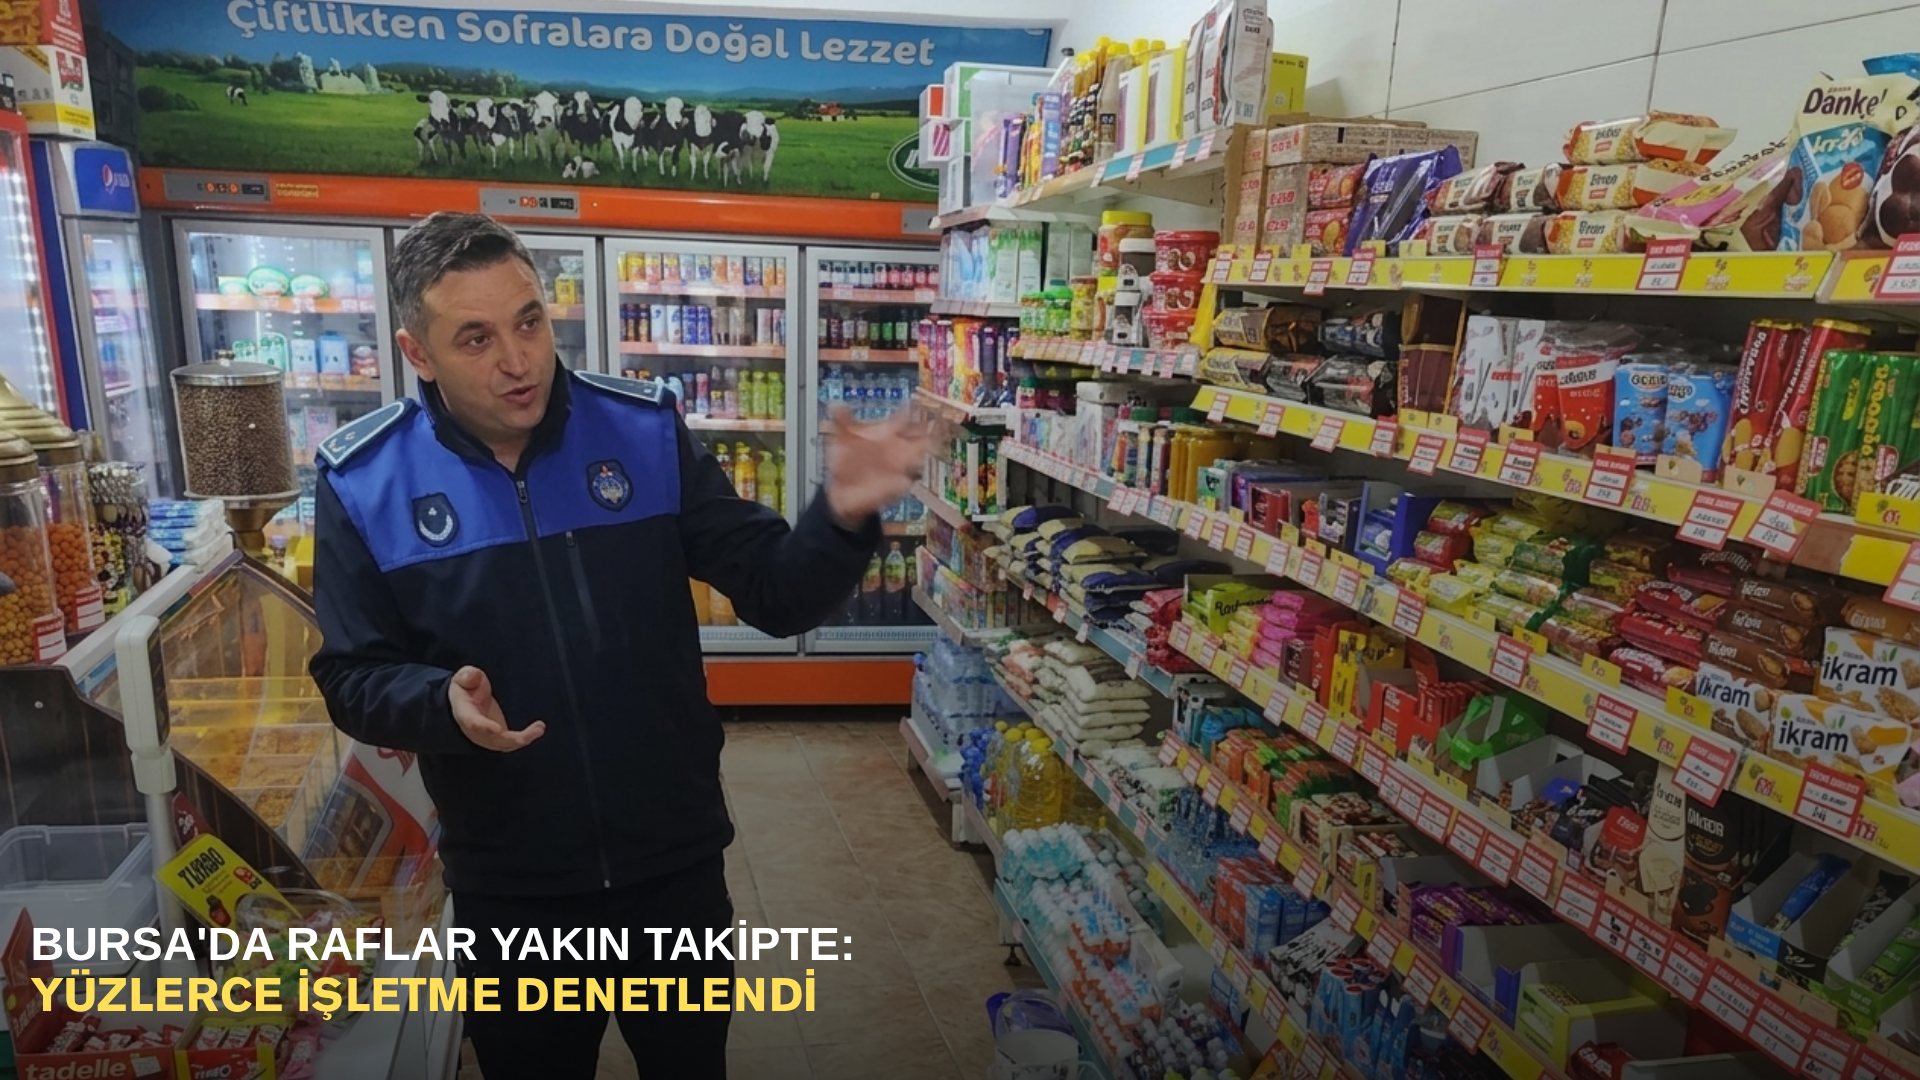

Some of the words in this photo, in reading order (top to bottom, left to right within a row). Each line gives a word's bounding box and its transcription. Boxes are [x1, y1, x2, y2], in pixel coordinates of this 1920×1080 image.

[226, 0, 446, 39] Çiftlikten
[456, 12, 653, 51] Sofralara
[665, 23, 789, 63] Doğal
[801, 30, 936, 66] Lezzet
[1822, 656, 1898, 687] ikram
[1778, 721, 1848, 753] ikram
[25, 1059, 126, 1080] tadelle
